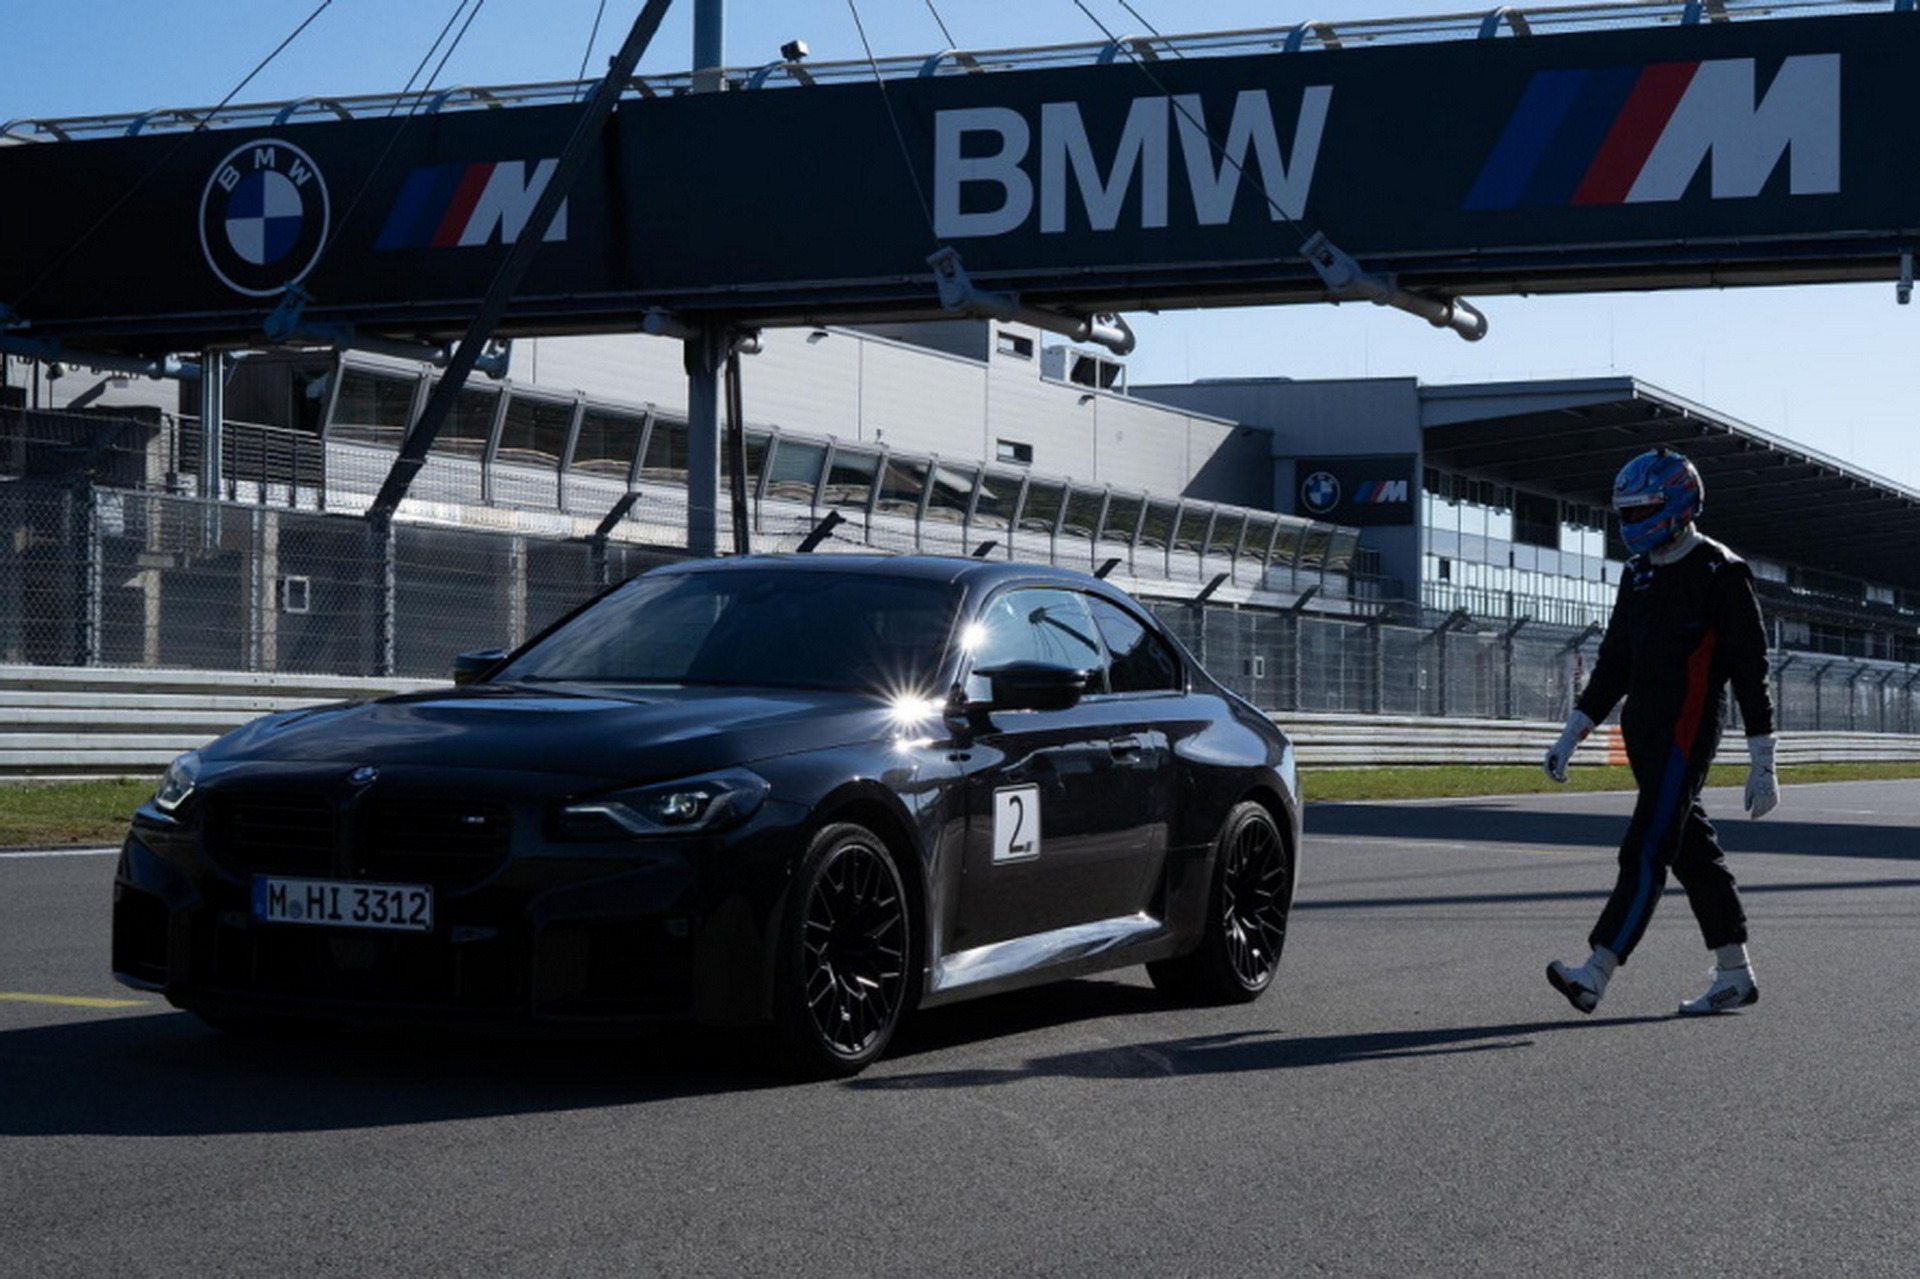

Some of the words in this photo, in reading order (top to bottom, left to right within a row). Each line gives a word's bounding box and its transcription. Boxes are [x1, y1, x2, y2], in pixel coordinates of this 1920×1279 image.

[218, 147, 313, 193] BMW
[934, 85, 1334, 239] BMW
[1623, 53, 1841, 203] M
[457, 158, 568, 247] M
[1008, 794, 1024, 854] 2
[269, 884, 286, 917] M
[306, 885, 342, 921] HI
[352, 888, 427, 925] 3312
